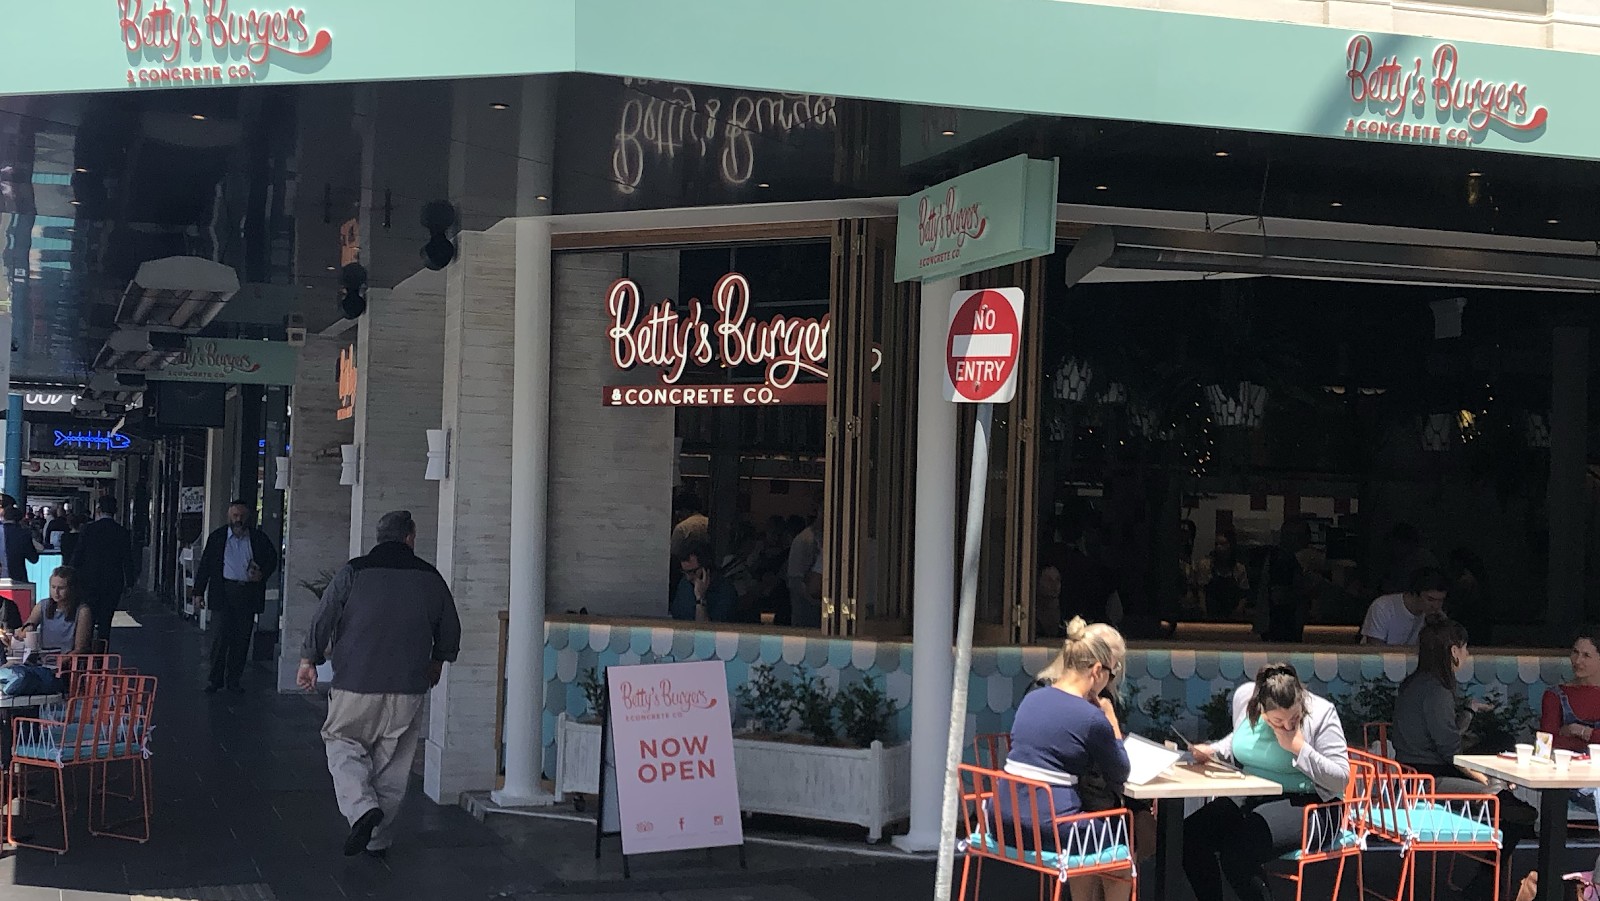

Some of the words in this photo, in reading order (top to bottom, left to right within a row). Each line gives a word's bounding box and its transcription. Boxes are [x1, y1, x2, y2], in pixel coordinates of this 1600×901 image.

[118, 0, 201, 63] Betty's
[205, 0, 332, 65] Burgers
[1346, 34, 1426, 118] Betty's
[1431, 43, 1549, 130] Burgers
[919, 196, 945, 252] Betty's
[946, 186, 987, 248] Burgers
[606, 277, 713, 385] Betty's
[713, 271, 830, 390] Burger
[973, 309, 996, 330] NO
[955, 360, 1006, 382] ENTRY
[620, 680, 660, 713] Betty's
[659, 678, 718, 713] Burgers
[639, 735, 709, 759] NOW
[637, 758, 716, 784] OPEN
